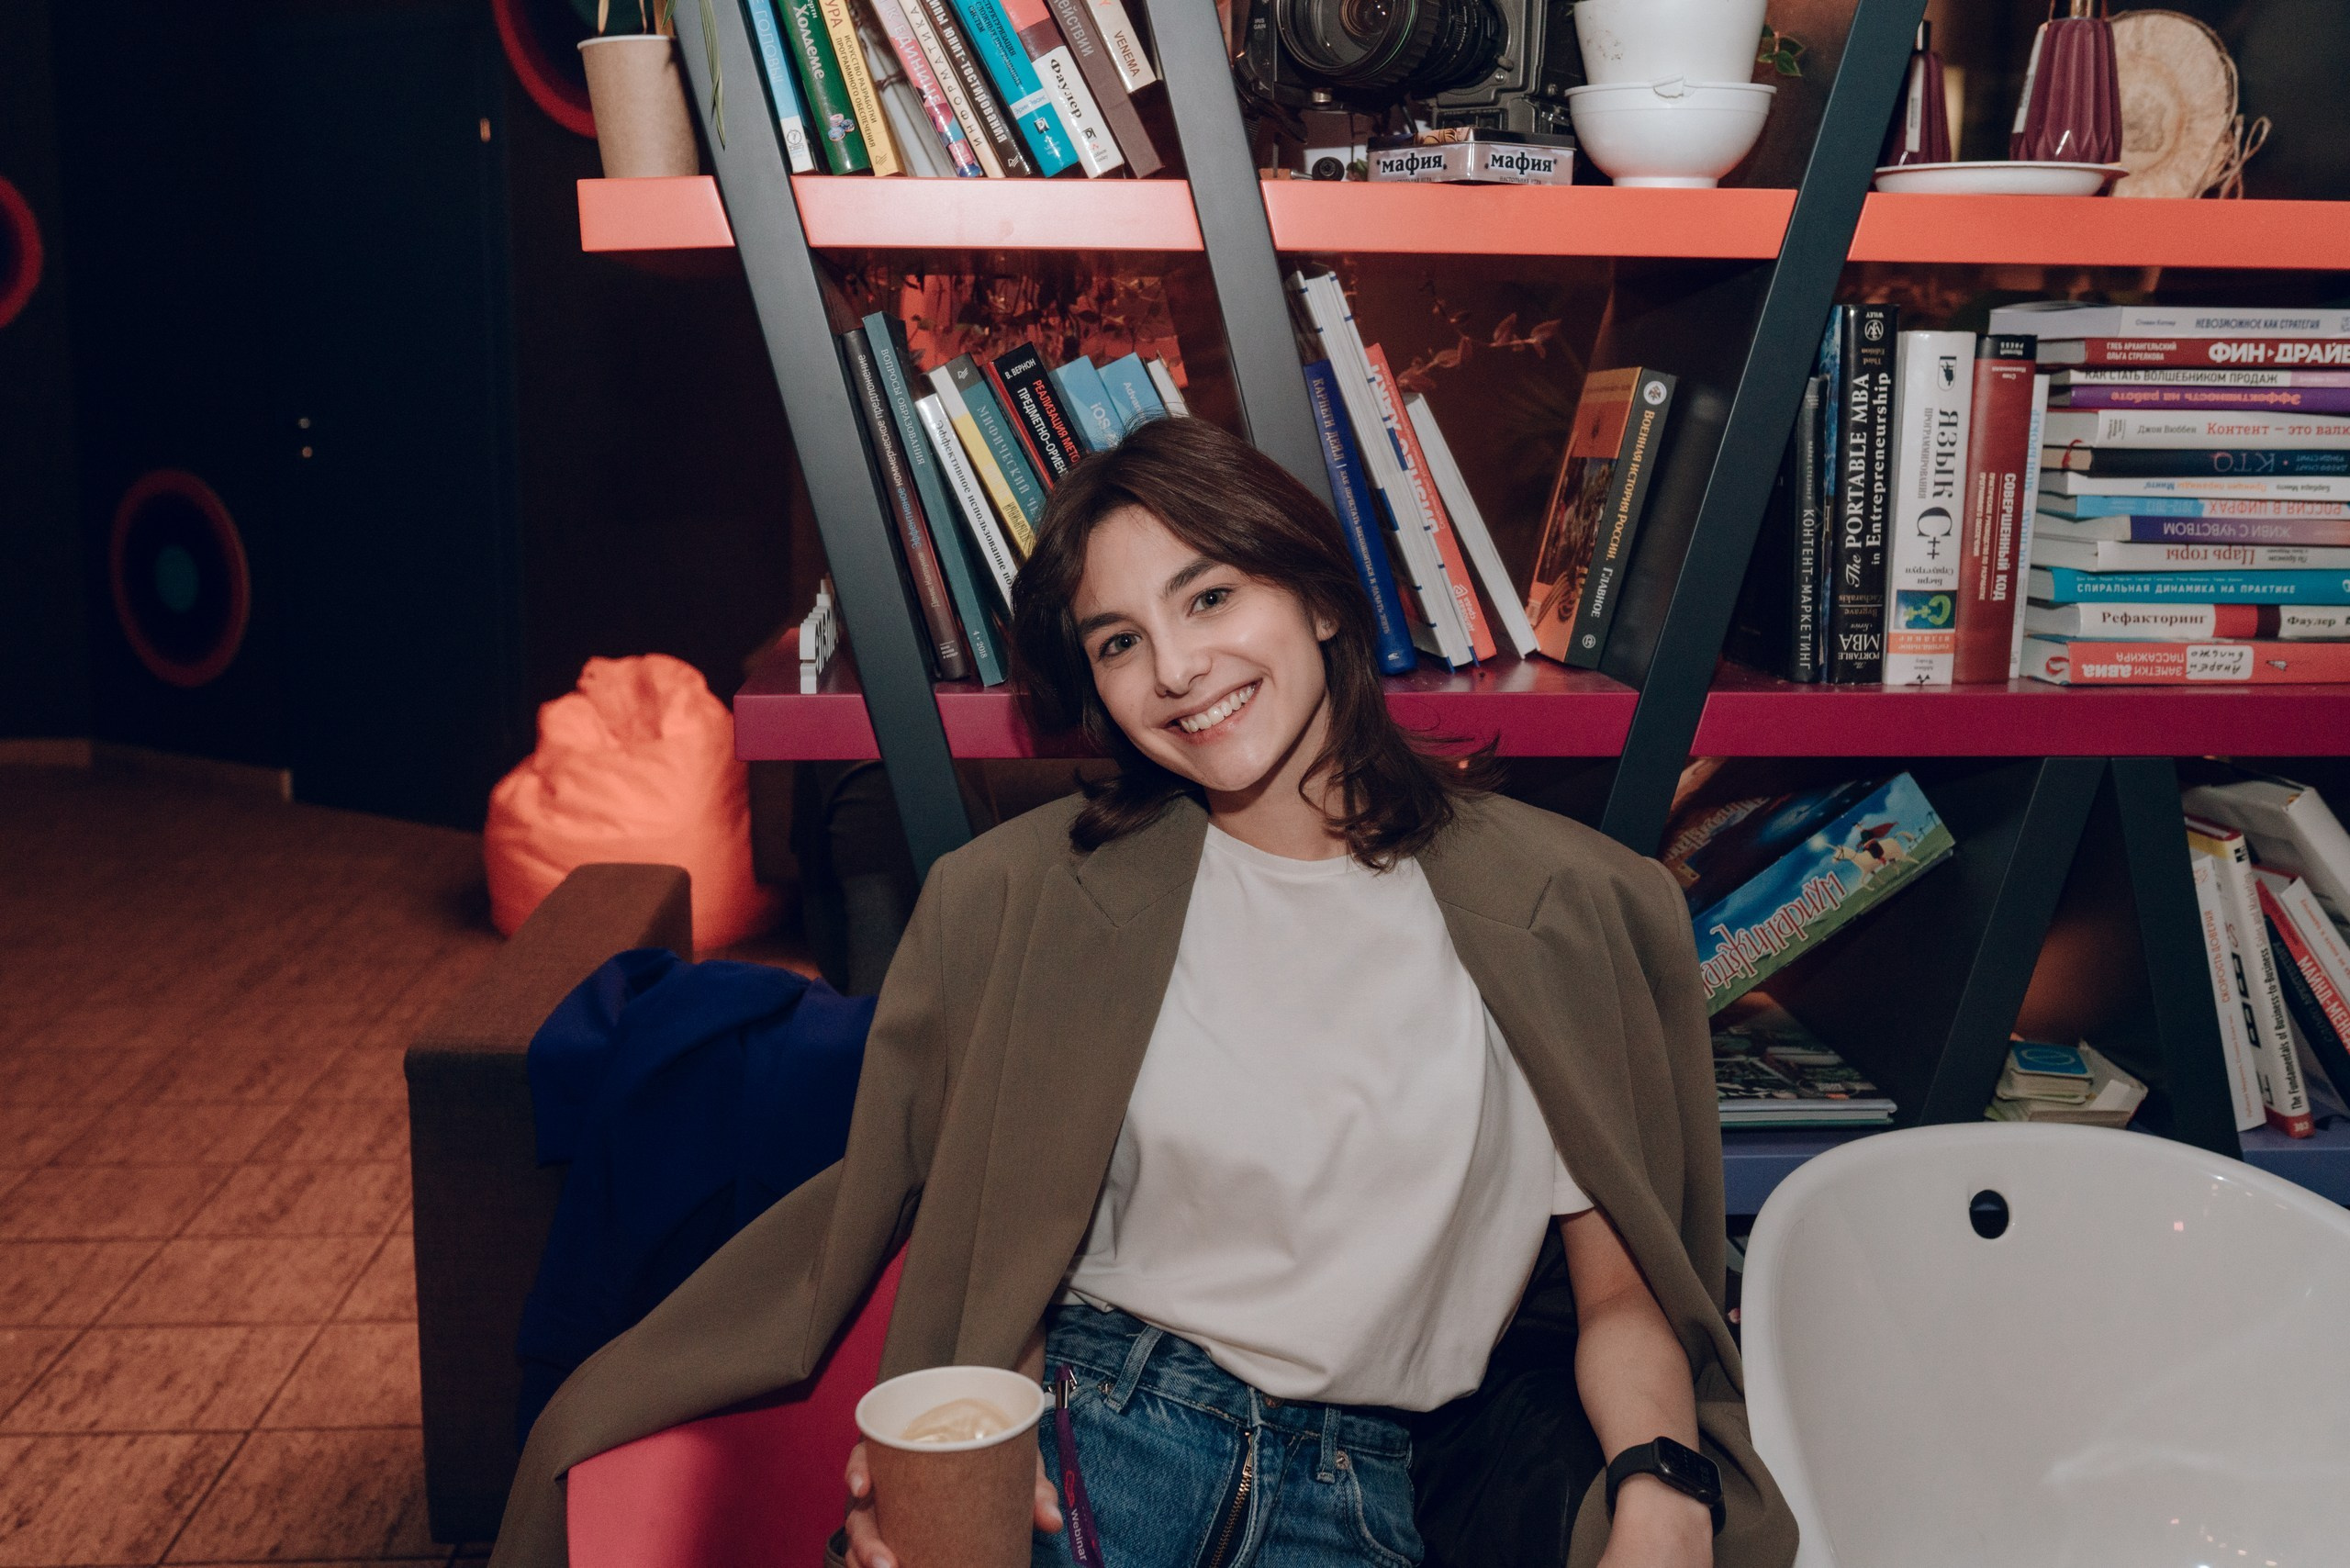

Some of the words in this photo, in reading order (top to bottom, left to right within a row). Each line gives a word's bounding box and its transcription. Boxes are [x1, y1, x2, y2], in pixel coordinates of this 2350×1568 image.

[968, 5, 986, 33] СИСТЕМ
[1053, 0, 1095, 57] ействии
[793, 4, 824, 80] Холдеме
[1113, 30, 1141, 77] VENEMA
[845, 34, 863, 77] ИСКУССТВО
[857, 77, 878, 124] РАЗРАБОТКИ
[894, 24, 941, 103] ЕДИНИЦЕ
[911, 6, 983, 147] ИНФОРМАТИКА
[835, 38, 858, 96] ПРОГРАММНОГО
[855, 96, 877, 148] ОБЕСПЕЧЕНИЯ
[1050, 58, 1082, 119] Фаулер
[1381, 152, 1443, 175] мафия
[1491, 151, 1553, 175] мафия
[2195, 318, 2261, 329] НЕВОЗМОЖНОЕ
[2263, 319, 2277, 329] КАК
[2279, 319, 2321, 330] СТРАТЕГИЯ
[1012, 358, 1036, 376] ВЕРНОН
[2085, 370, 2107, 380] КАК
[2109, 370, 2141, 381] СТАТЬ
[2143, 370, 2226, 384] ВОЛШЕБНИКОМ
[2230, 373, 2277, 385] ПРОДАЖ
[858, 355, 883, 420] предложение
[881, 349, 901, 396] ВОПРОСЫ
[899, 397, 925, 465] ОБРАЗОВАНИЯ
[1851, 373, 1870, 423] MBA
[2110, 390, 2160, 404] работе
[2163, 392, 2181, 401] на
[2184, 390, 2300, 405] Эффективность
[1017, 386, 1069, 477] ПРЕДМЕТНО-ОРИЕН
[1033, 378, 1069, 439] РЕАЛИЗАЦИЯ
[1062, 434, 1081, 464] МЕТО
[1091, 401, 1111, 430] iOS
[1313, 377, 1336, 429] КАРНЕГИ
[1325, 431, 1344, 461] ДЕЙЛ
[2137, 424, 2162, 434] Джон
[2206, 421, 2270, 436] Контент
[2288, 425, 2312, 436] это
[877, 420, 903, 487] коммерческое
[978, 405, 1030, 495] МИФИЧЕСКИЙ
[1631, 409, 1656, 465] ВОЕННАЯ
[1918, 408, 1933, 499] ПРОГРАММИРОВАНИЯ
[1932, 409, 1959, 498] ЯЗЫК
[1339, 470, 1349, 485] КАК
[1865, 372, 1892, 547] Entrepreneurship
[2212, 451, 2276, 473] КТО
[935, 420, 971, 494] Эффективное
[968, 493, 1006, 572] использование
[1619, 465, 1640, 514] ИСТОРИЯ
[1845, 431, 1867, 549] PORTABLE
[2210, 500, 2267, 514] ЦИФРАХ
[2273, 501, 2281, 515] В
[2287, 501, 2342, 515] РОССИЯ
[897, 487, 922, 549] Эффективное
[1917, 507, 1953, 560] C++
[1997, 473, 2017, 571] СОВЕРШЕННЫЙ
[2163, 521, 2237, 536] ЧУВСТВОМ
[2240, 523, 2248, 537] С
[2252, 523, 2291, 538] ЖИВИ
[1845, 553, 1862, 588] The
[1871, 553, 1881, 566] in
[2166, 544, 2208, 561] горы
[2212, 544, 2255, 566] Царь
[1591, 566, 1614, 619] ГЛАВНОЕ
[1799, 509, 1815, 670] КОНТЕНТ-МАРКЕТИНГ
[1992, 574, 2008, 601] КОД
[2076, 583, 2150, 594] СПИРАЛЬНАЯ
[2154, 584, 2215, 594] ДИНАМИКА
[2221, 584, 2235, 594] НА
[2240, 584, 2296, 594] ПРАКТИКЕ
[2101, 610, 2207, 626] Рефакторинг
[2287, 616, 2336, 627] Фаулер
[976, 641, 988, 659] 2018
[1838, 652, 1880, 660] PORTABLE
[1839, 633, 1881, 652] MBA
[2116, 651, 2184, 662] ПАССАЖИРА
[2134, 666, 2183, 676] ЗАМЕТКИ
[2203, 910, 2221, 953] ДОВЕРИЯ
[2213, 953, 2231, 1003] СКОРОСТЬ
[2278, 1041, 2300, 1095] Fundamentals
[2289, 1095, 2303, 1112] The
[1071, 1507, 1088, 1561] webinar
